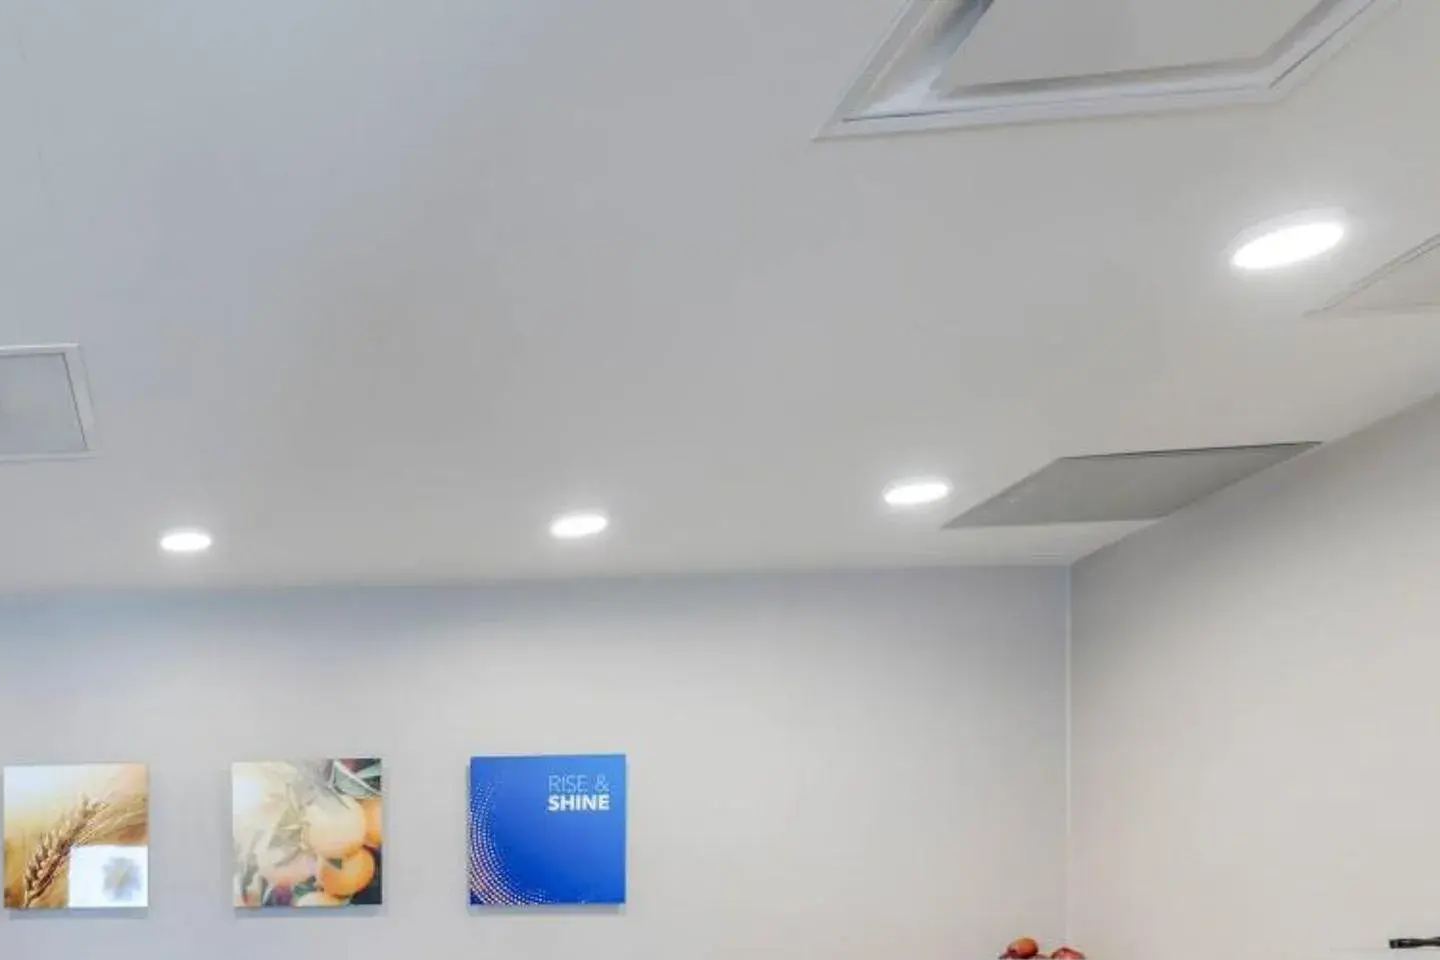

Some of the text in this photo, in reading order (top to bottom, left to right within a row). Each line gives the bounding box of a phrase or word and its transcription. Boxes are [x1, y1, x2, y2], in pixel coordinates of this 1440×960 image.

[548, 773, 610, 793] RISE &
[547, 794, 610, 812] SHINE
